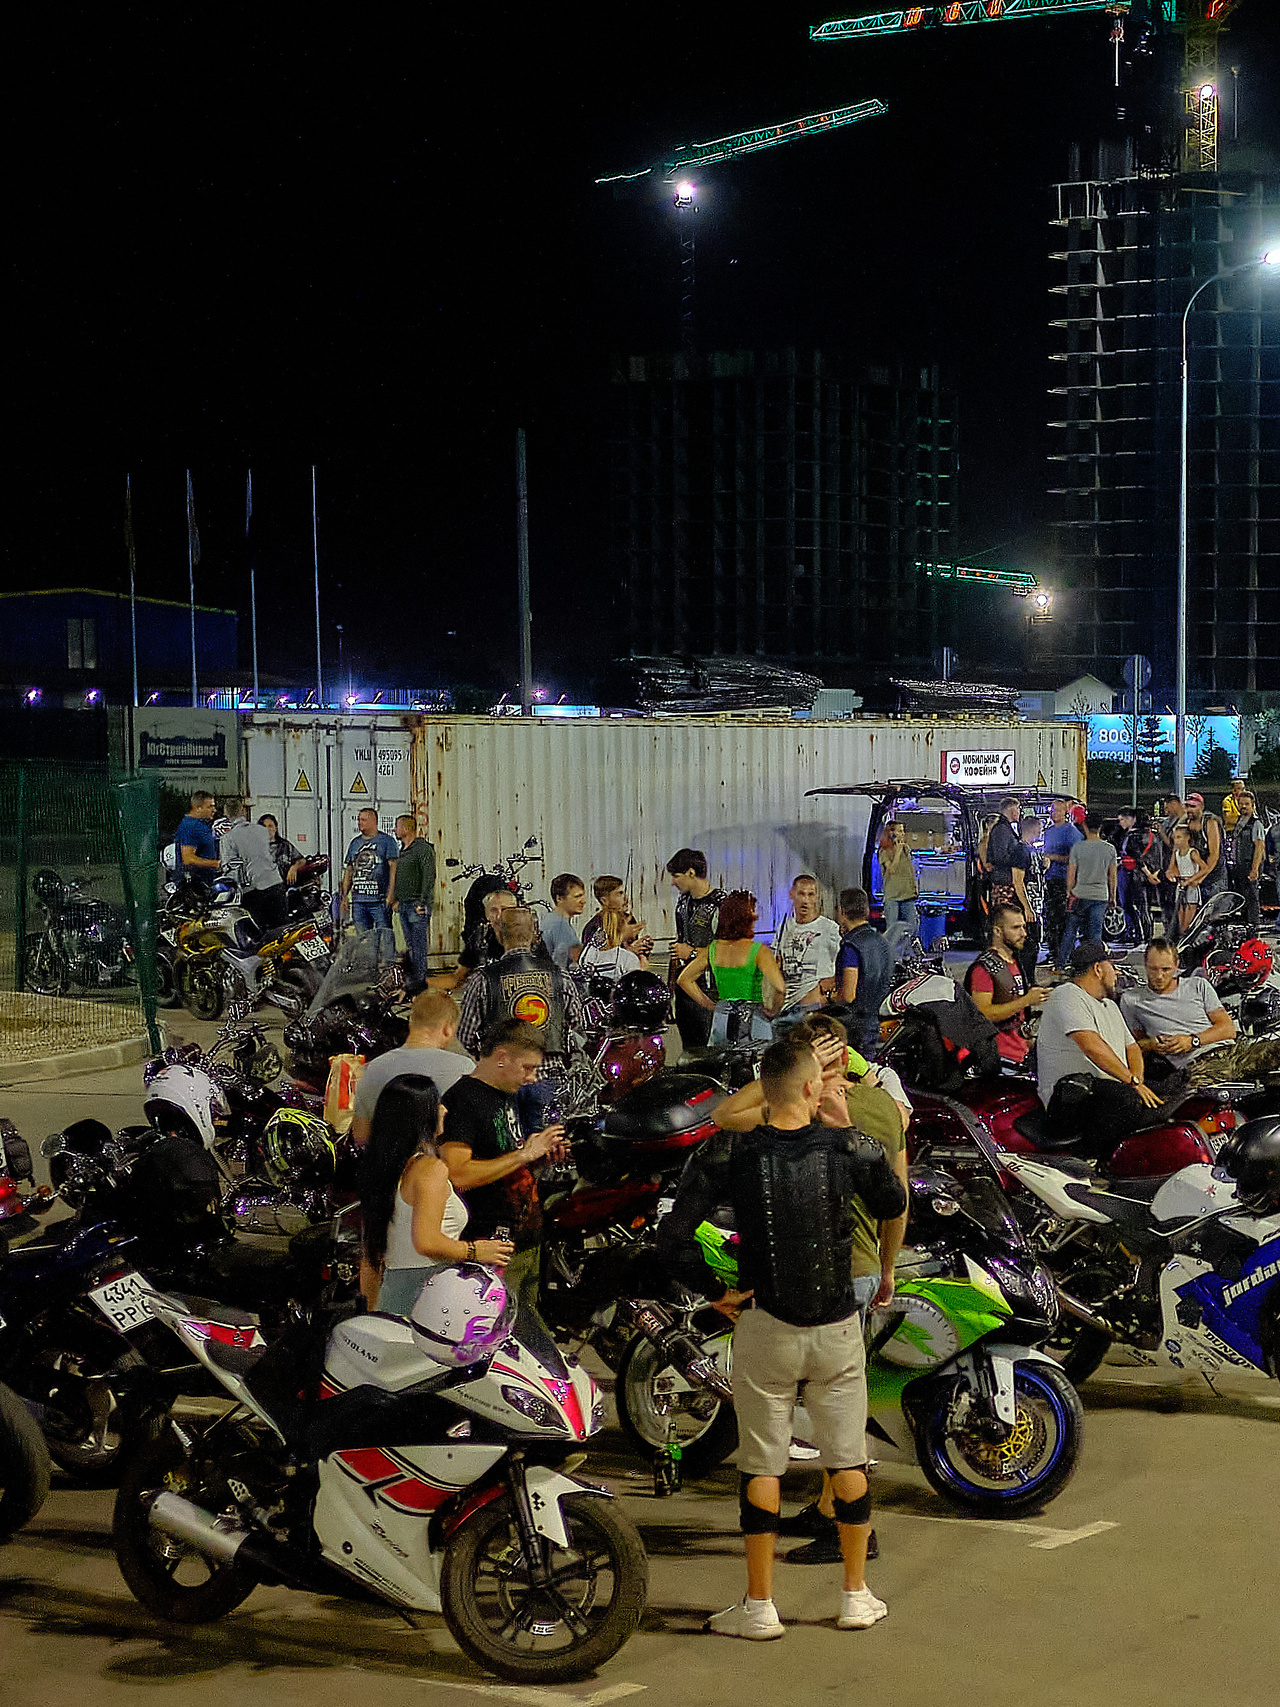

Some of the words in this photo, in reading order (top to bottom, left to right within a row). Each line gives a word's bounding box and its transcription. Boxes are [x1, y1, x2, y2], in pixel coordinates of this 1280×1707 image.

[962, 754, 1000, 765] МОБИЛЬНАЯ
[964, 765, 998, 777] КОФЕЙНЯ
[103, 1278, 141, 1303] 4341
[1203, 1329, 1256, 1371] DUNLOP
